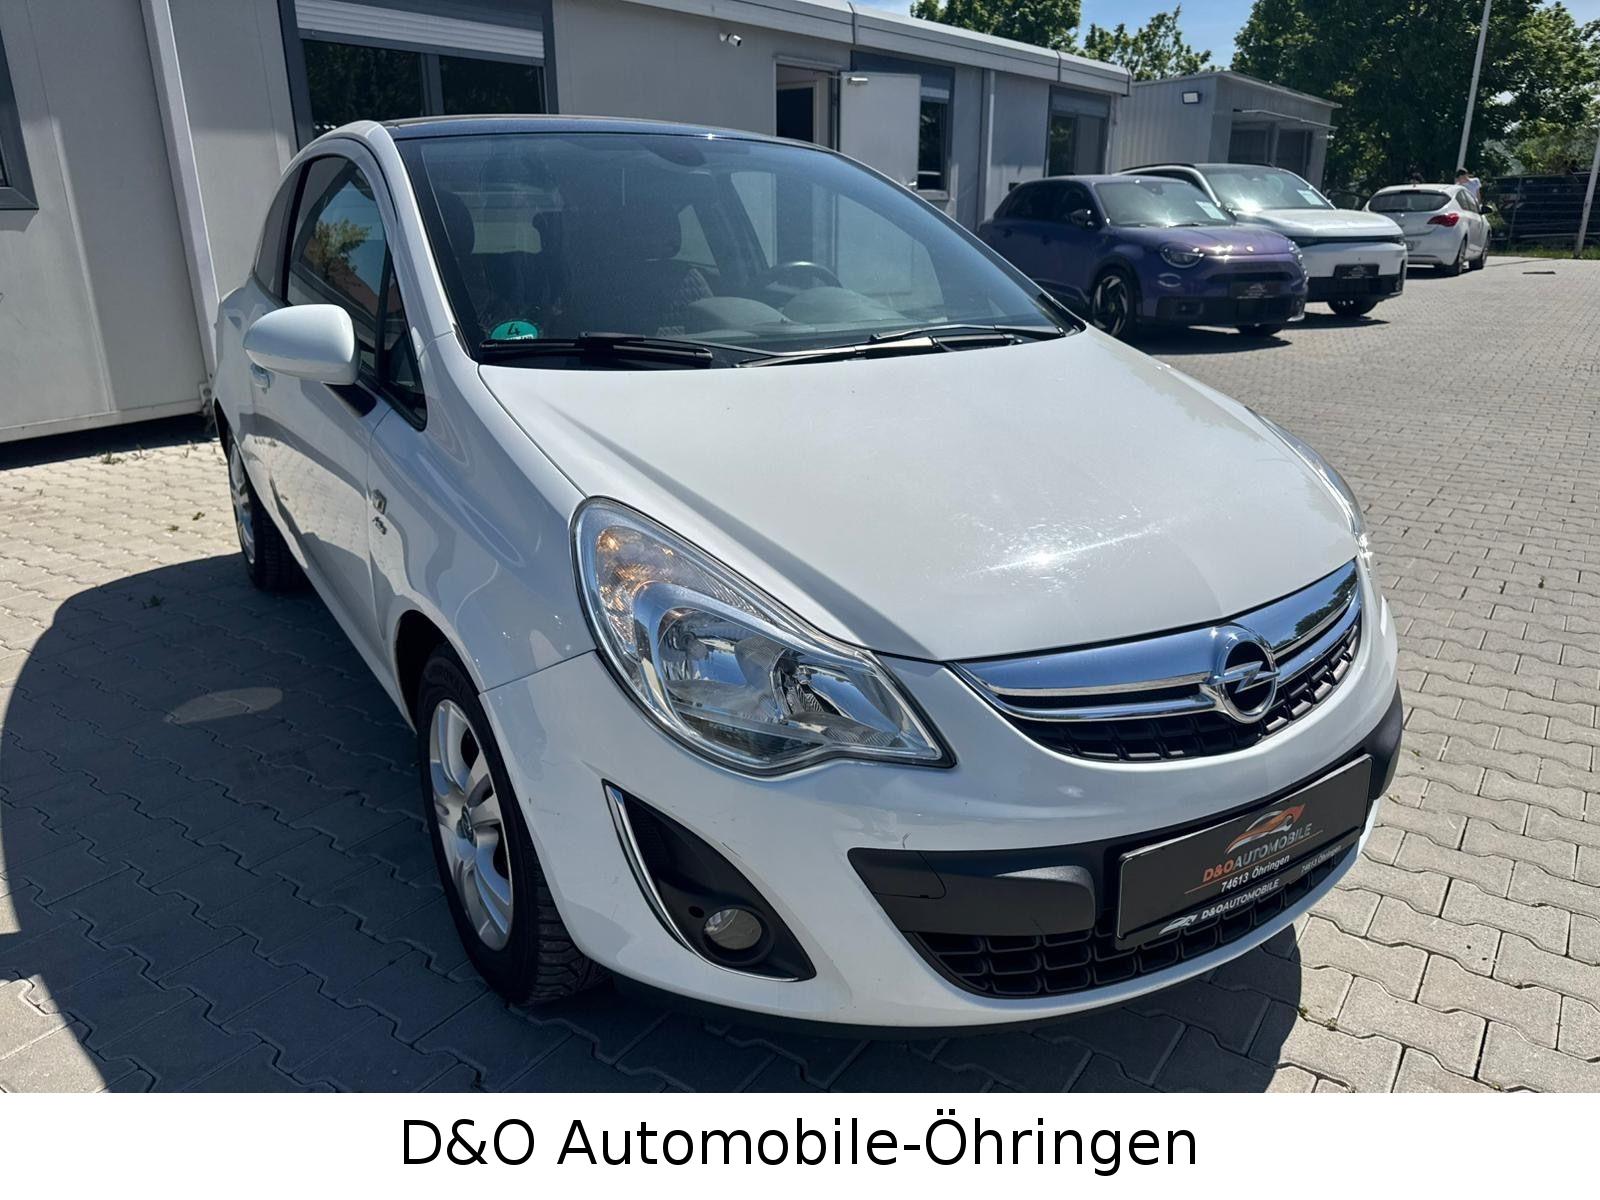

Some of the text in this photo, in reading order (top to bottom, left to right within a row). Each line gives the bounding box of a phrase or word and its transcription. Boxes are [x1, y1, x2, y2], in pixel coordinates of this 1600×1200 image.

[507, 323, 520, 336] 4
[1202, 823, 1313, 883] D&OAUTOMOBILE
[1220, 853, 1291, 893] 74613 Öhringen
[1201, 878, 1280, 920] D&OAUTOMOBILE
